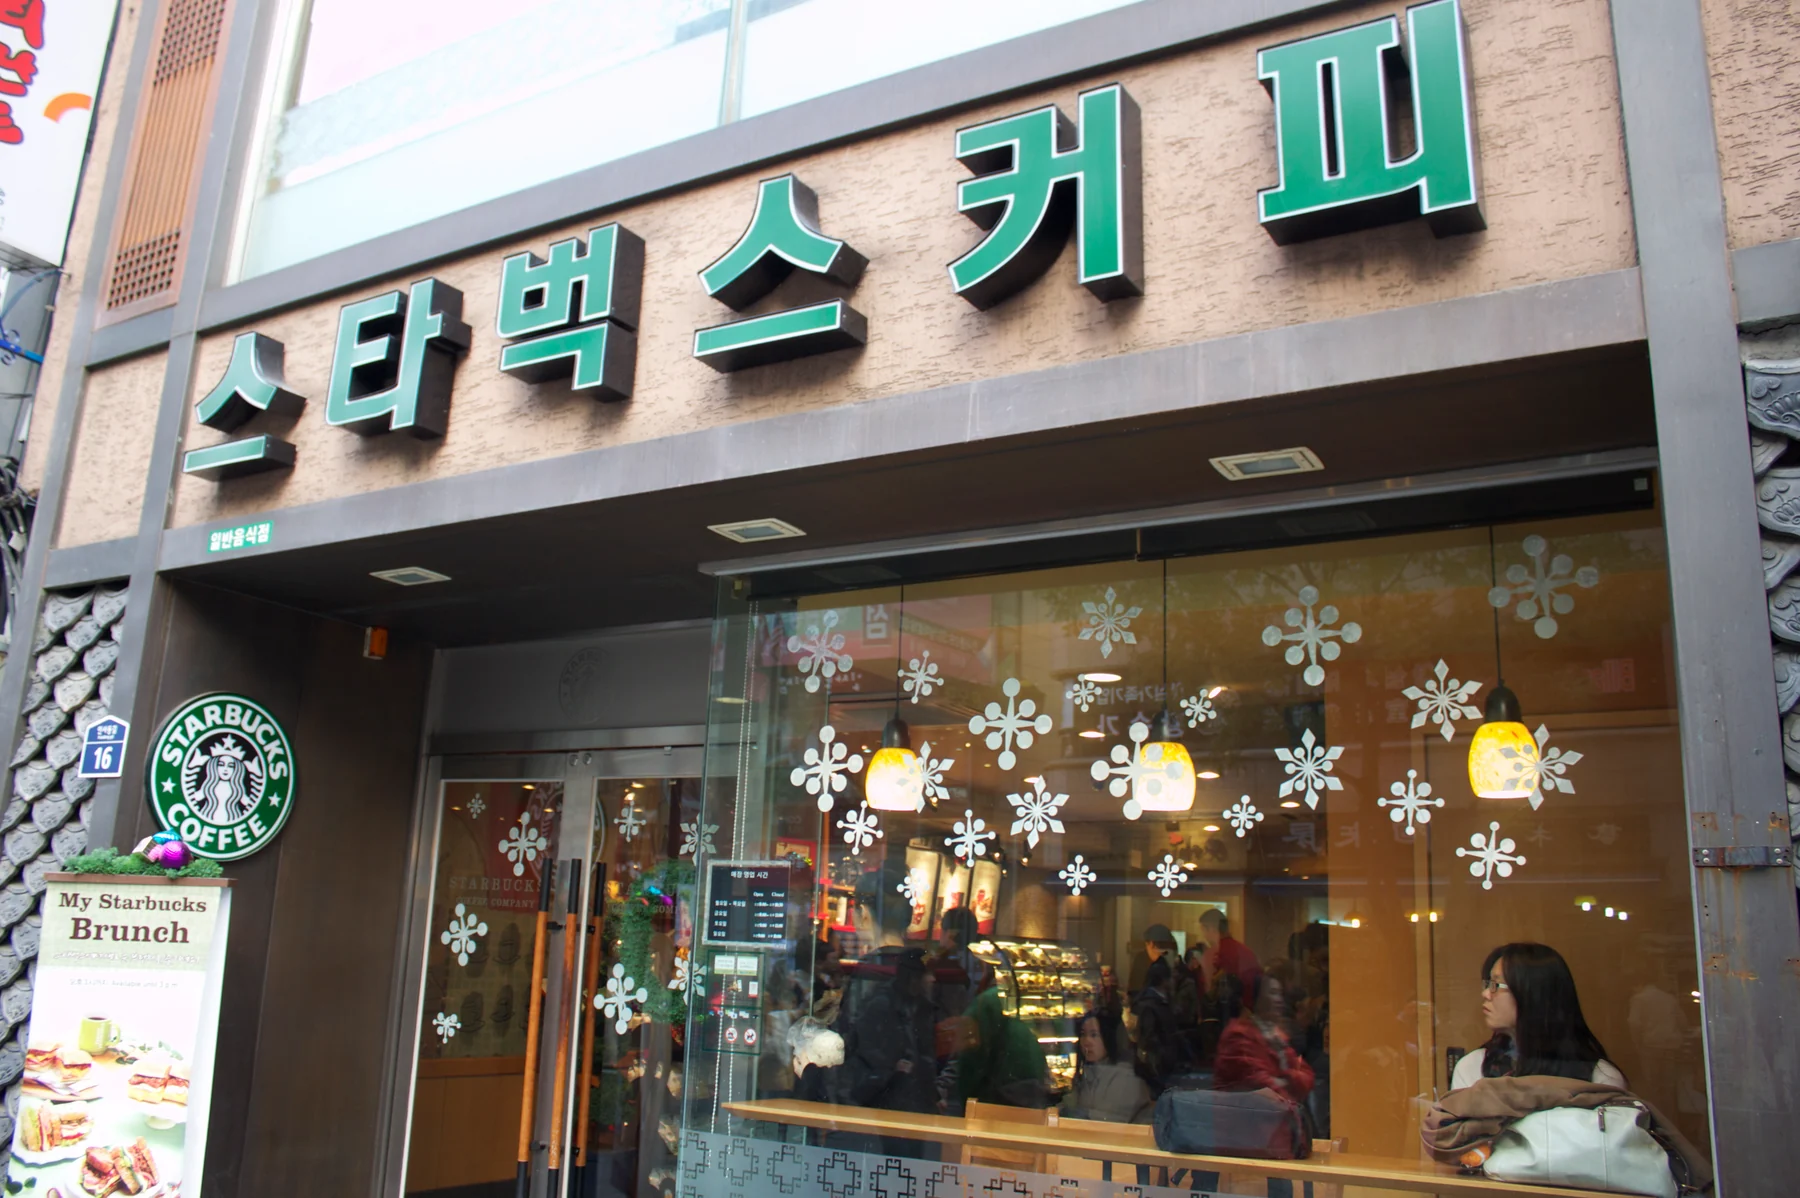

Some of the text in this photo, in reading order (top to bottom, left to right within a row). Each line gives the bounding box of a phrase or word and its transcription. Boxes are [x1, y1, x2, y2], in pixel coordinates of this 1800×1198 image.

[210, 523, 270, 551] 일반음식점
[162, 704, 288, 780] STARBUCKS
[94, 746, 113, 770] 16
[168, 803, 267, 850] COFFEE
[58, 892, 207, 912] My Starbucks
[491, 898, 535, 908] COMPANY
[69, 917, 190, 944] Brunch
